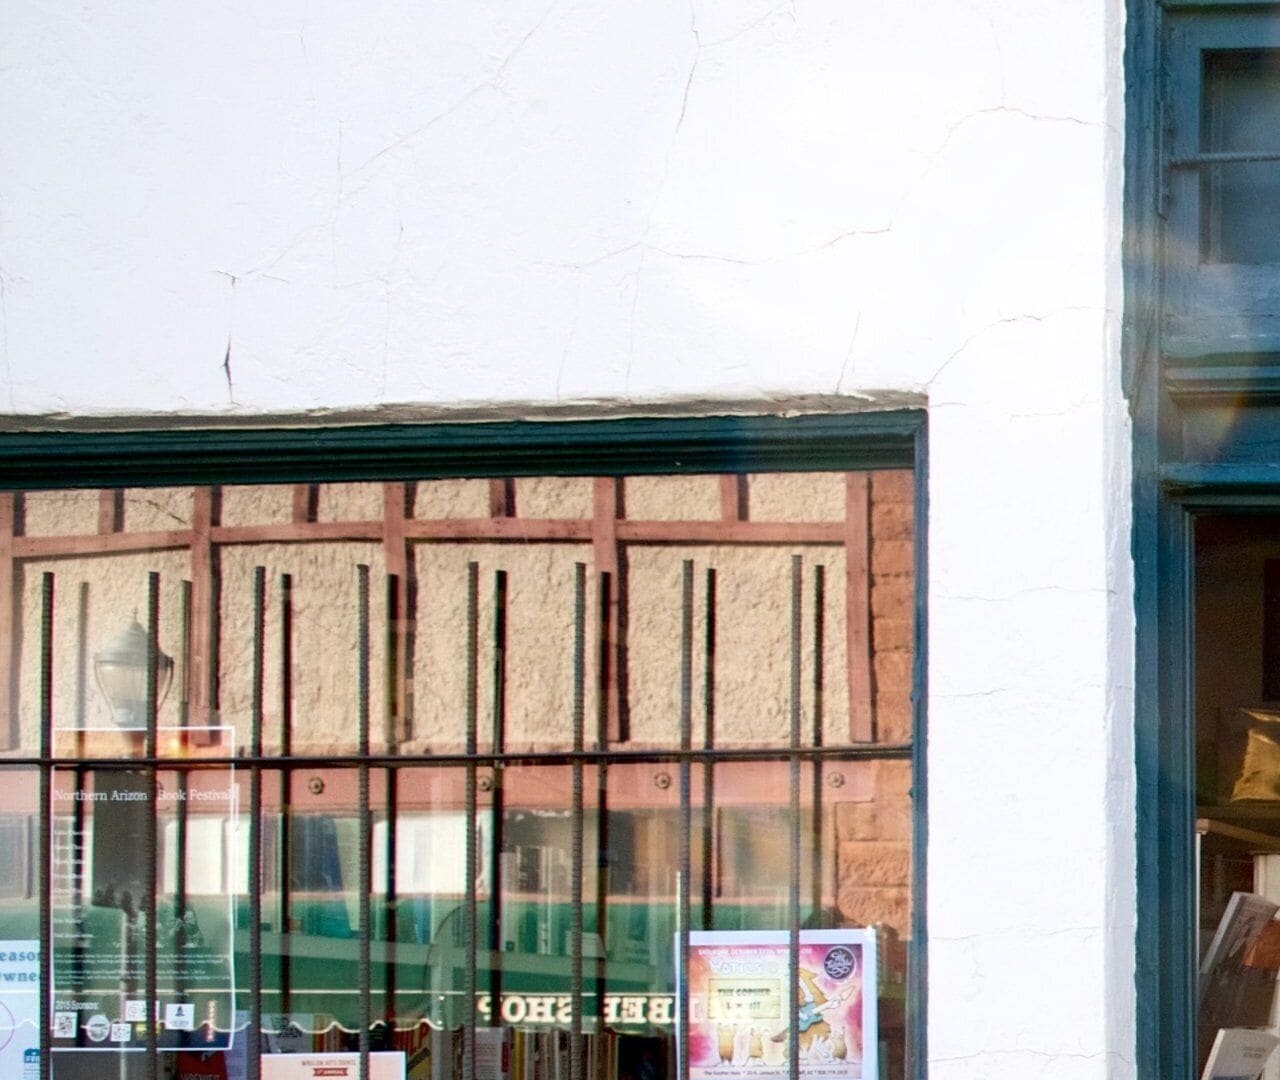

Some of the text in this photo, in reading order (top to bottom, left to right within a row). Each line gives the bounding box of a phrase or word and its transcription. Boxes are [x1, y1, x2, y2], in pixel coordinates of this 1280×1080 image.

[55, 790, 107, 801] Northern
[110, 790, 148, 801] Arizon
[158, 790, 186, 800] Book
